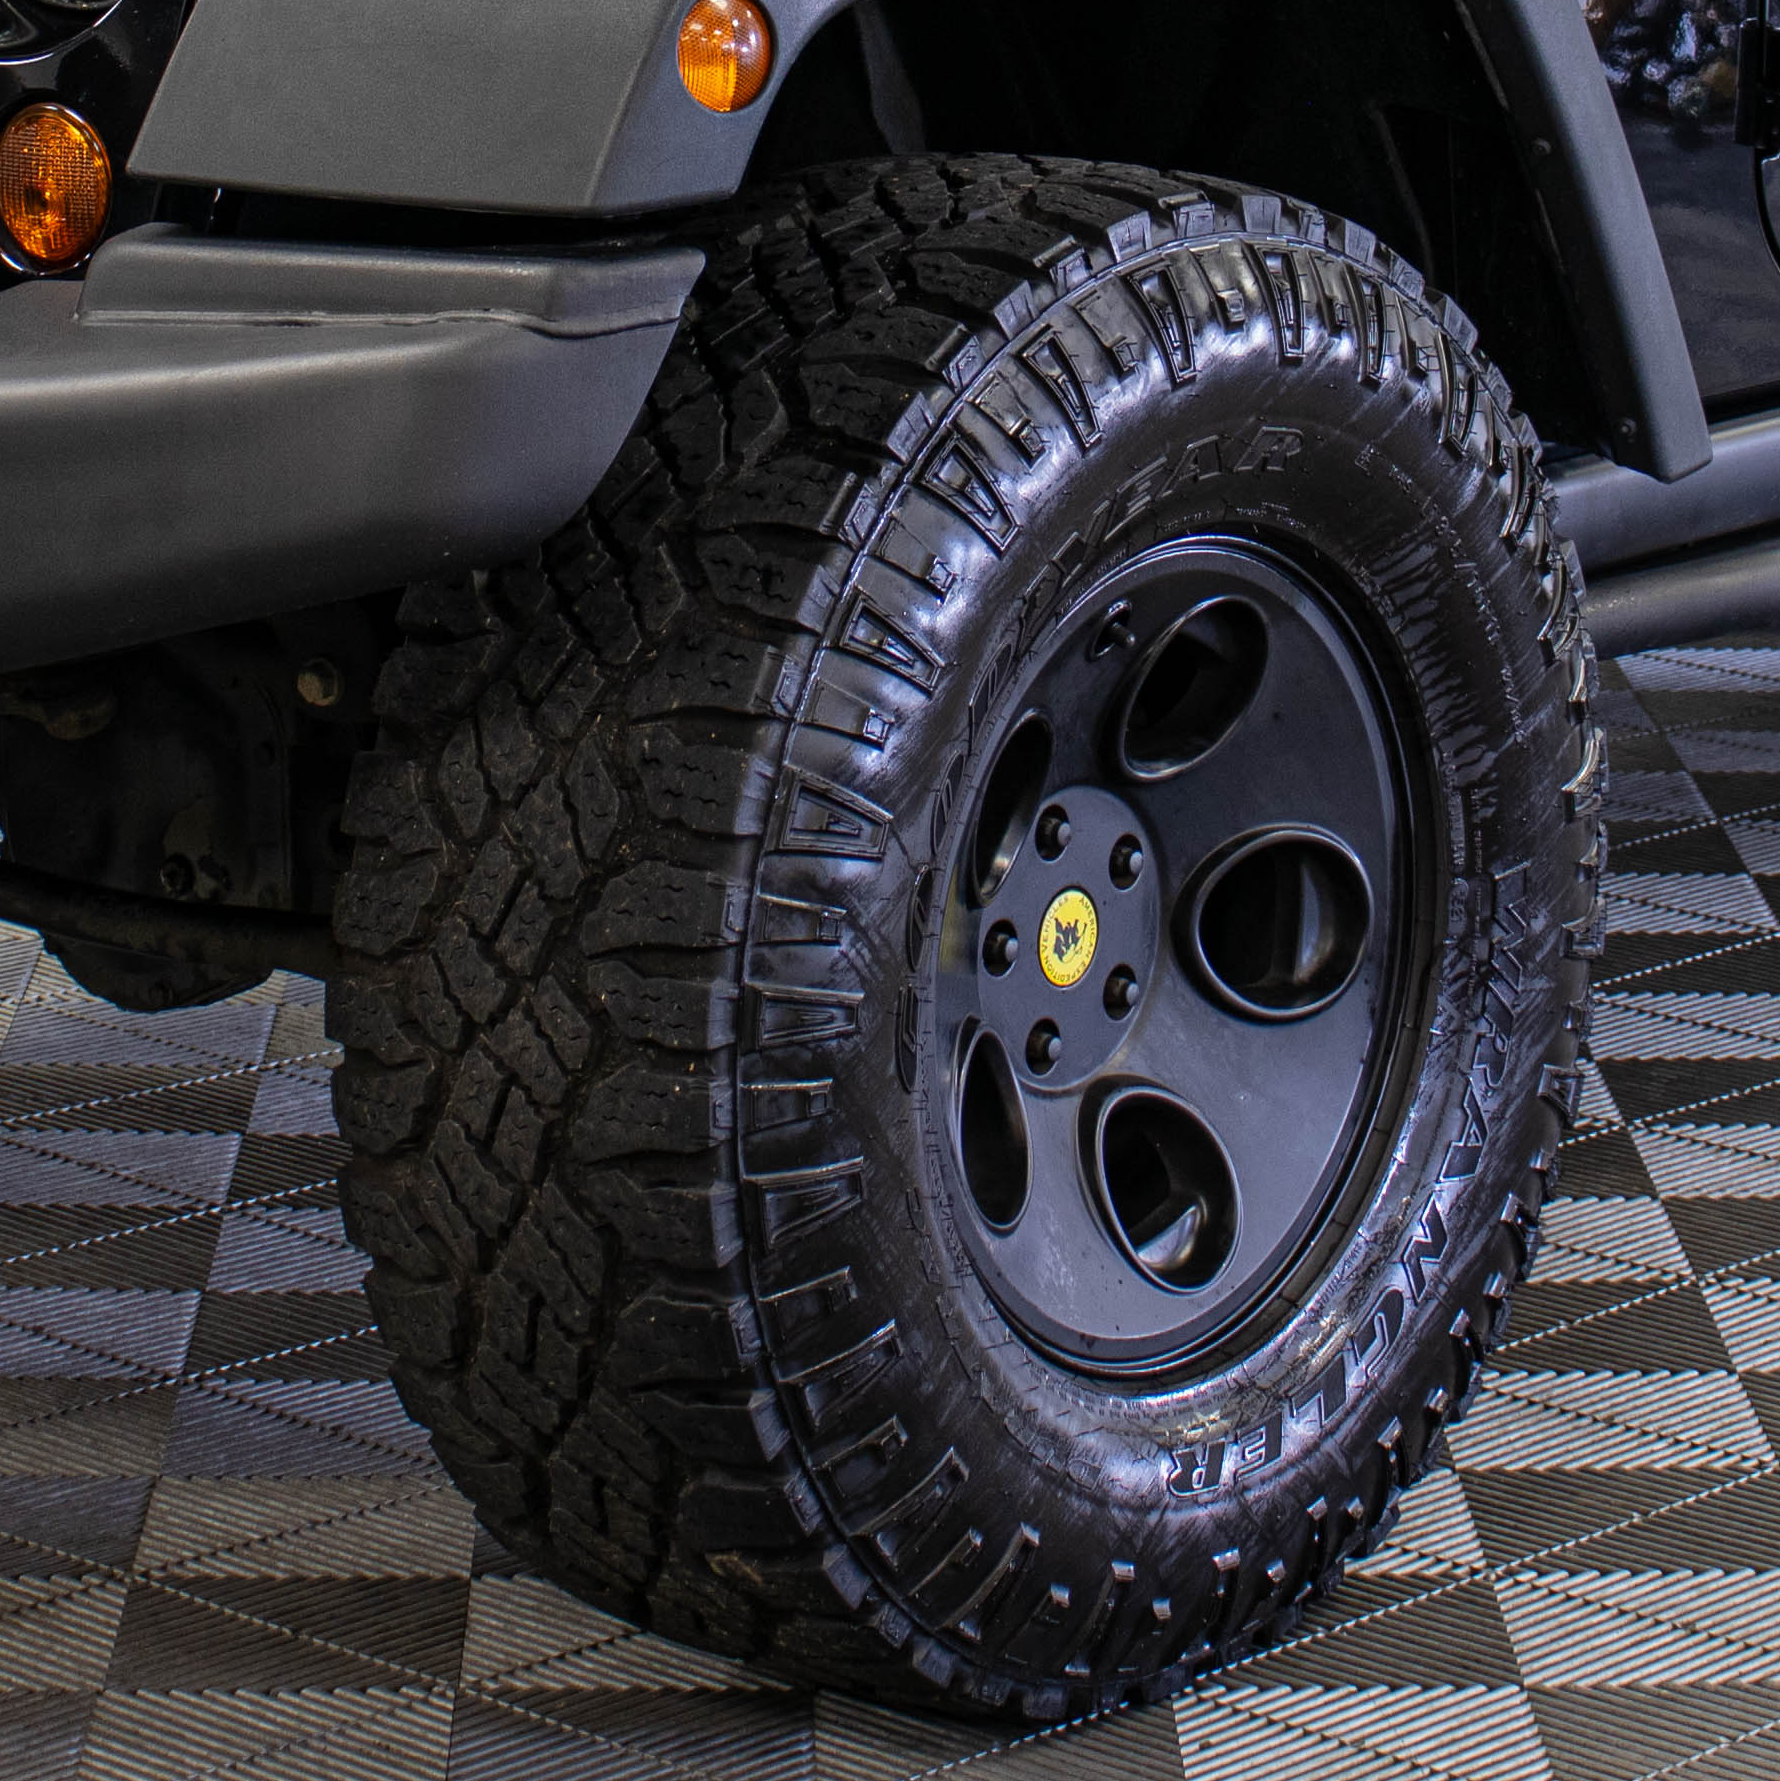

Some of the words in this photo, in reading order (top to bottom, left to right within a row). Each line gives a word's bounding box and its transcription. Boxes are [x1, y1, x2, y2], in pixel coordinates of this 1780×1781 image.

[895, 426, 1306, 1095] GOODYEAR
[1041, 895, 1069, 952] VEHICLES
[1079, 897, 1096, 958] AMERICAN
[1044, 956, 1086, 982] EXPEDITION
[1167, 859, 1532, 1499] WRANGLER
